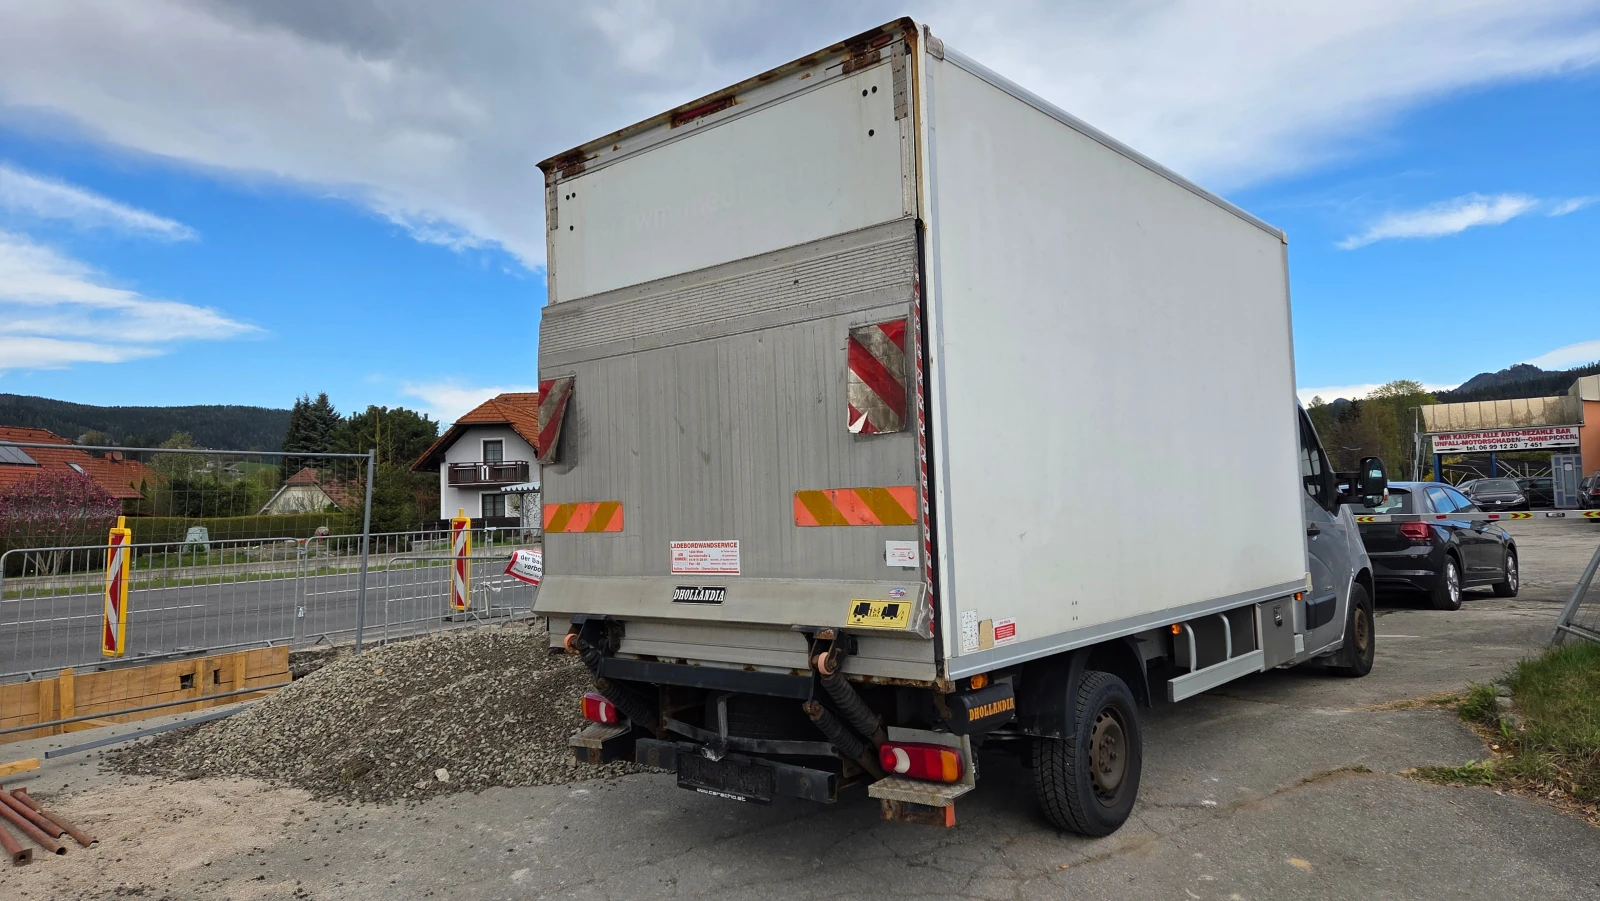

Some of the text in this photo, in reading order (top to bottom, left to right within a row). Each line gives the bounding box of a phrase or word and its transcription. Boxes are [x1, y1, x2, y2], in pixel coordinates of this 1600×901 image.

[1501, 429, 1554, 437] AUTO-BEZAHLE
[673, 589, 725, 602] DHOLLANDIA
[969, 697, 1015, 721] DHOLLANDIA
